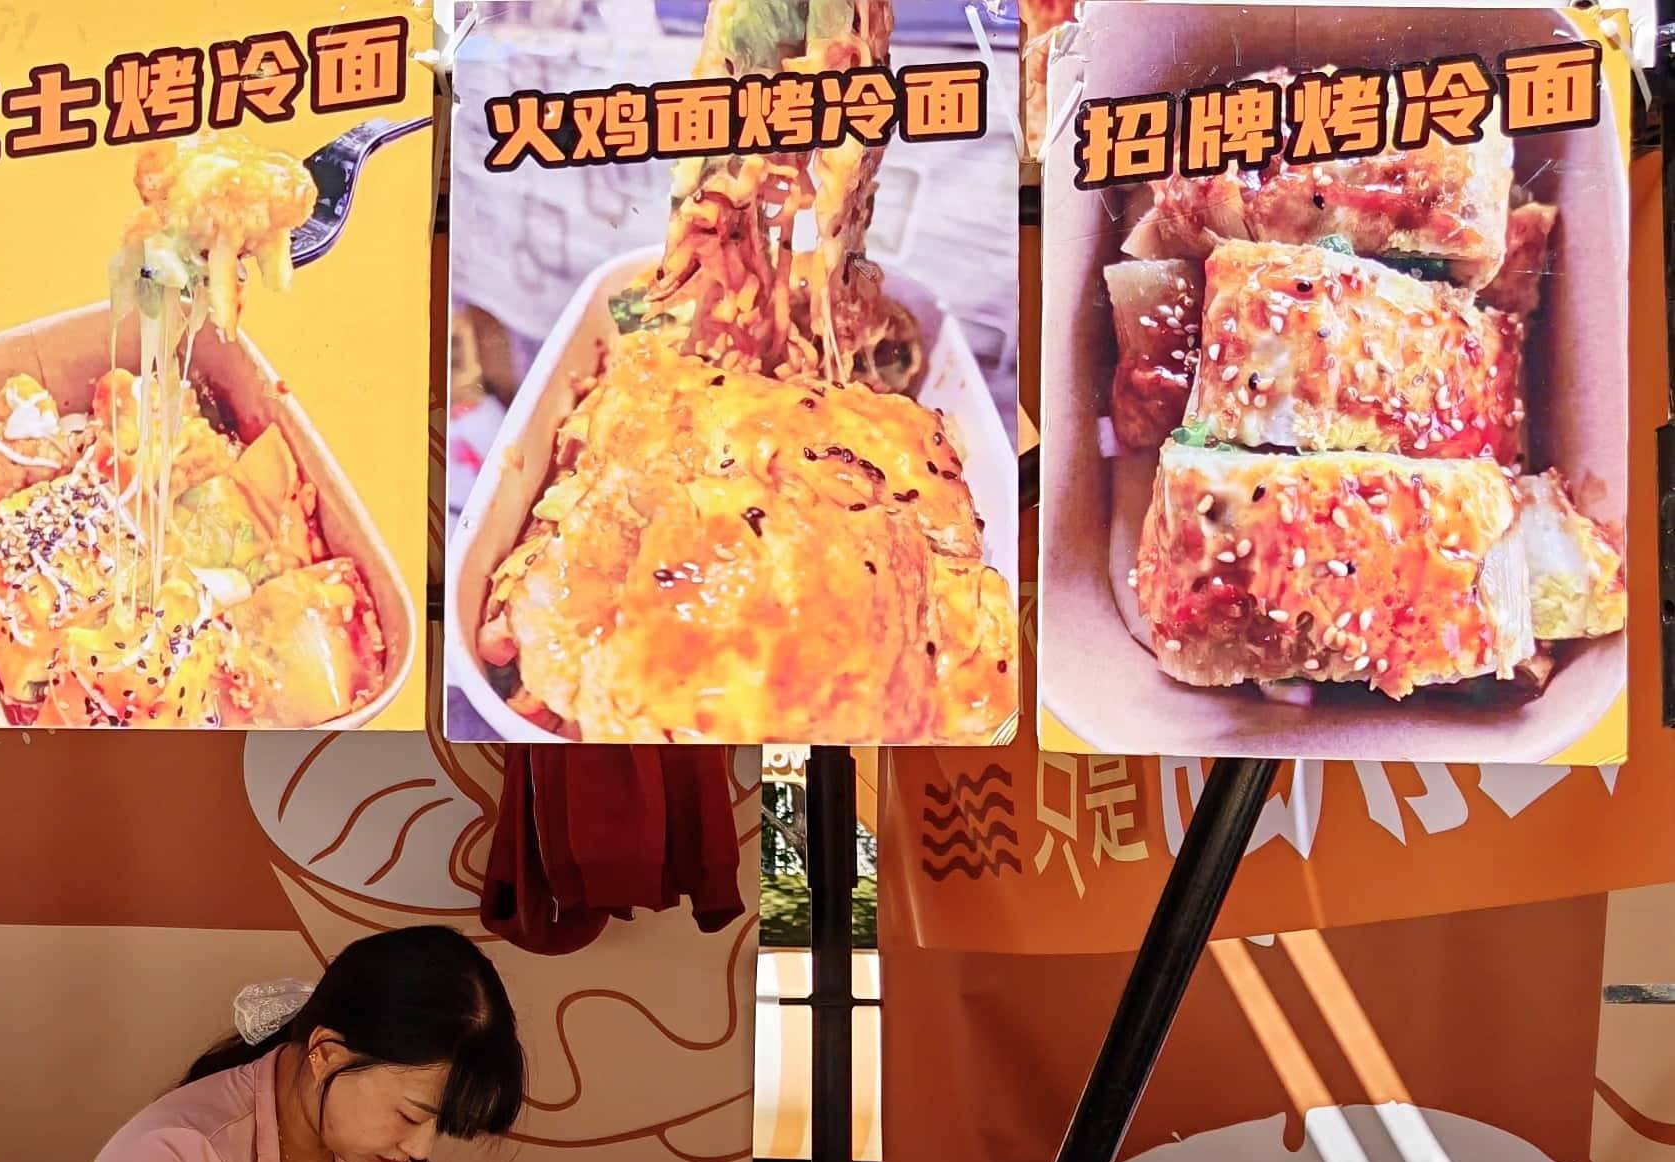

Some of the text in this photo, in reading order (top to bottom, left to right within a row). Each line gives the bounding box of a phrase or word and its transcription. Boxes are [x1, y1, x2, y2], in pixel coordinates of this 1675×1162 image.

[484, 62, 988, 173] 火鸡面烤冷面
[1074, 40, 1602, 190] 招牌烤冷面
